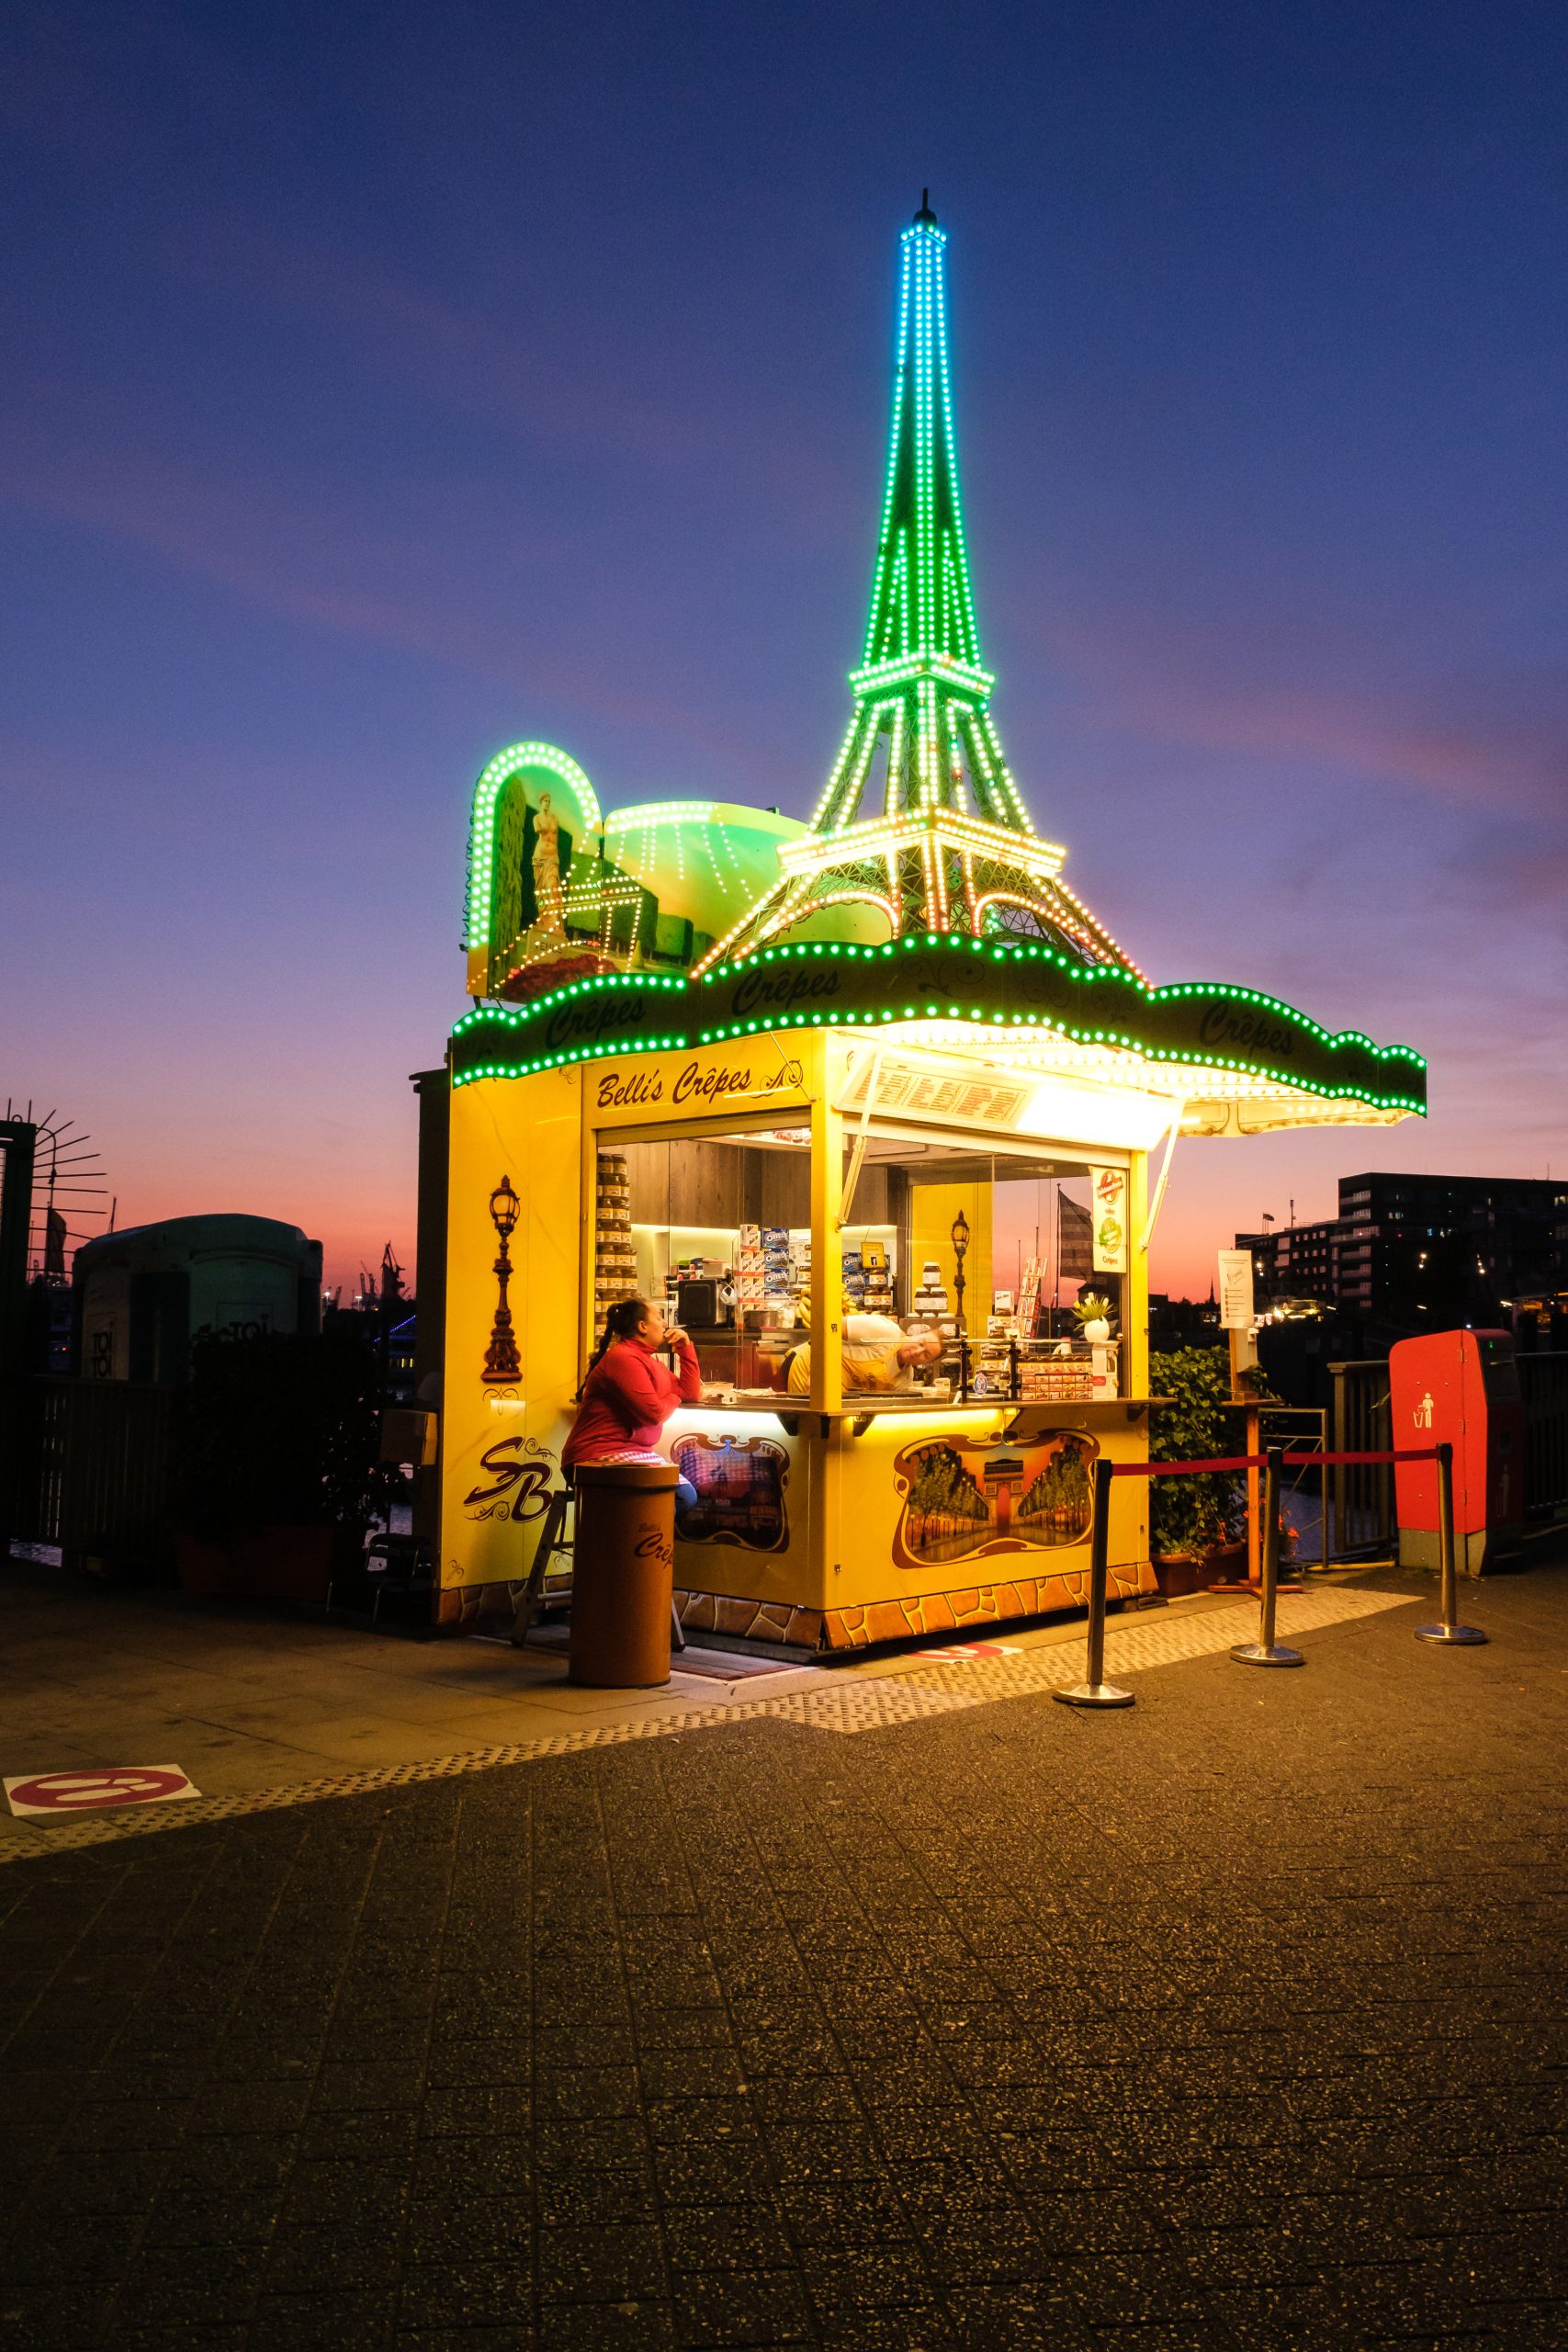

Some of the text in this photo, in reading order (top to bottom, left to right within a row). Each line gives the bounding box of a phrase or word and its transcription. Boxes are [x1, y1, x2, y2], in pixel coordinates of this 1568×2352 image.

[732, 967, 841, 1016] Crêpes
[546, 997, 647, 1050] Crêpes
[1200, 1000, 1294, 1057] Crêpes
[597, 1061, 752, 1108] Belli's Crêpes
